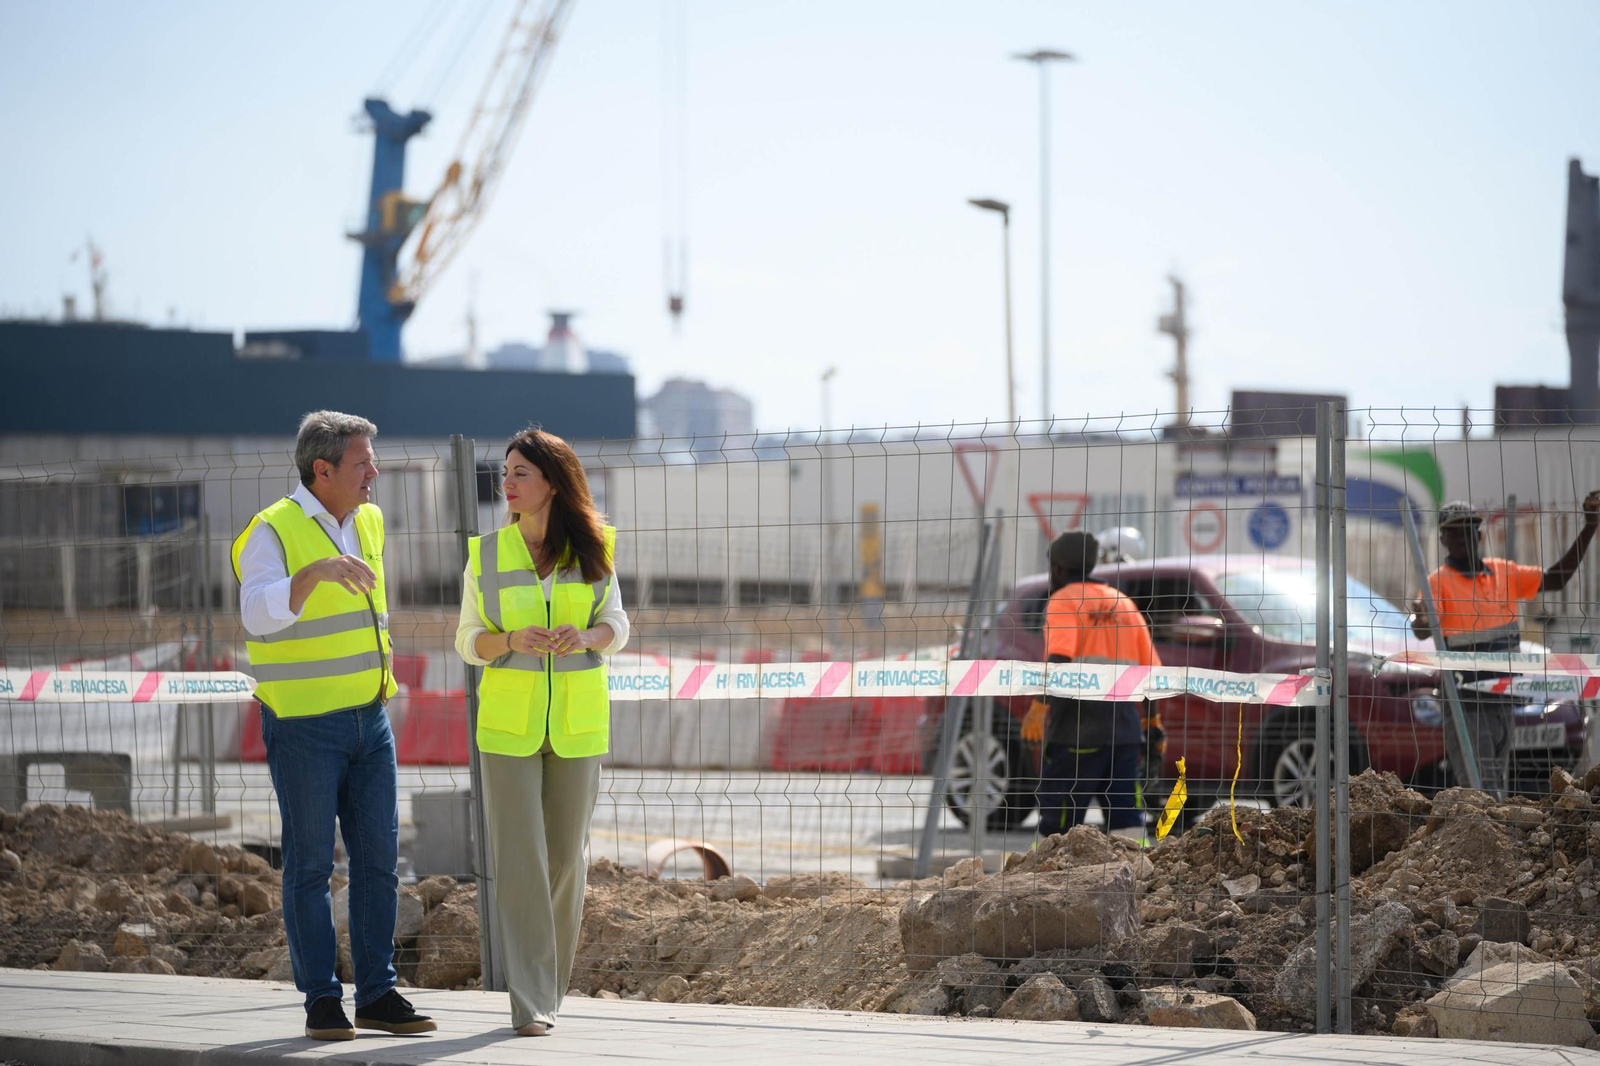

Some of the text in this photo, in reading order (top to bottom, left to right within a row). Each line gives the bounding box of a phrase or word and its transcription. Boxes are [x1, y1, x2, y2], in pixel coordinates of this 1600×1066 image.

[53, 679, 128, 694] HRMACESA
[998, 669, 1100, 690] HRMACESA
[1155, 675, 1256, 697] HMACESA
